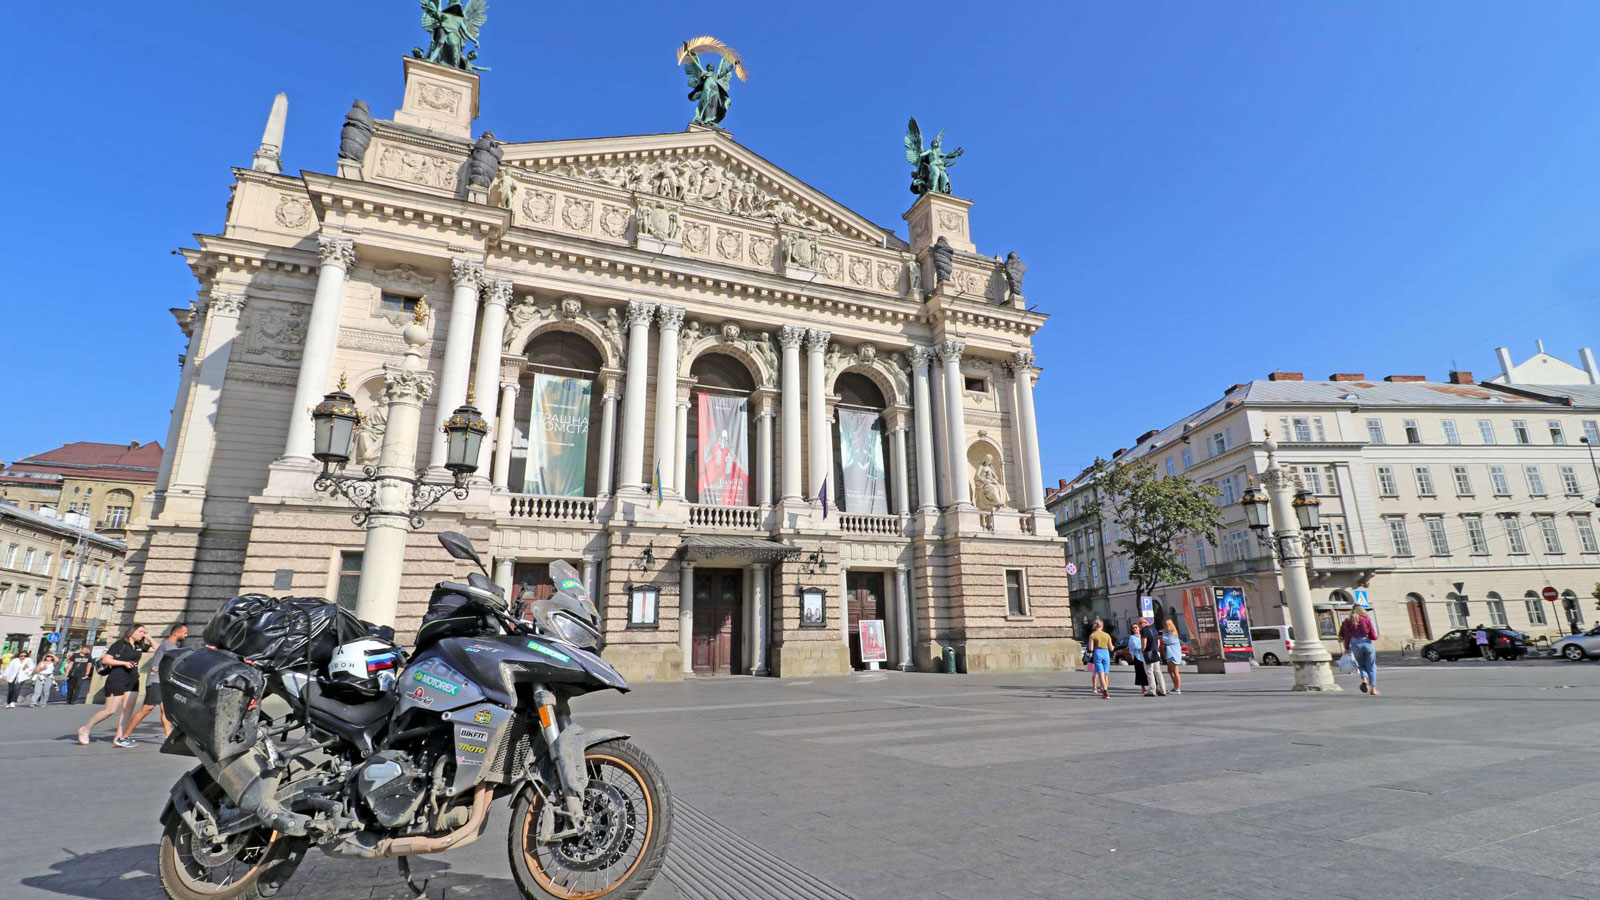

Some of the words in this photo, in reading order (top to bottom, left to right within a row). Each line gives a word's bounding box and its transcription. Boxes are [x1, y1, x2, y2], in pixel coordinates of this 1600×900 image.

[537, 421, 589, 434] ОМСТА
[1144, 598, 1150, 609] P
[537, 643, 569, 662] MOTOREX
[422, 673, 457, 696] MOTOREX
[458, 743, 487, 754] MOTO
